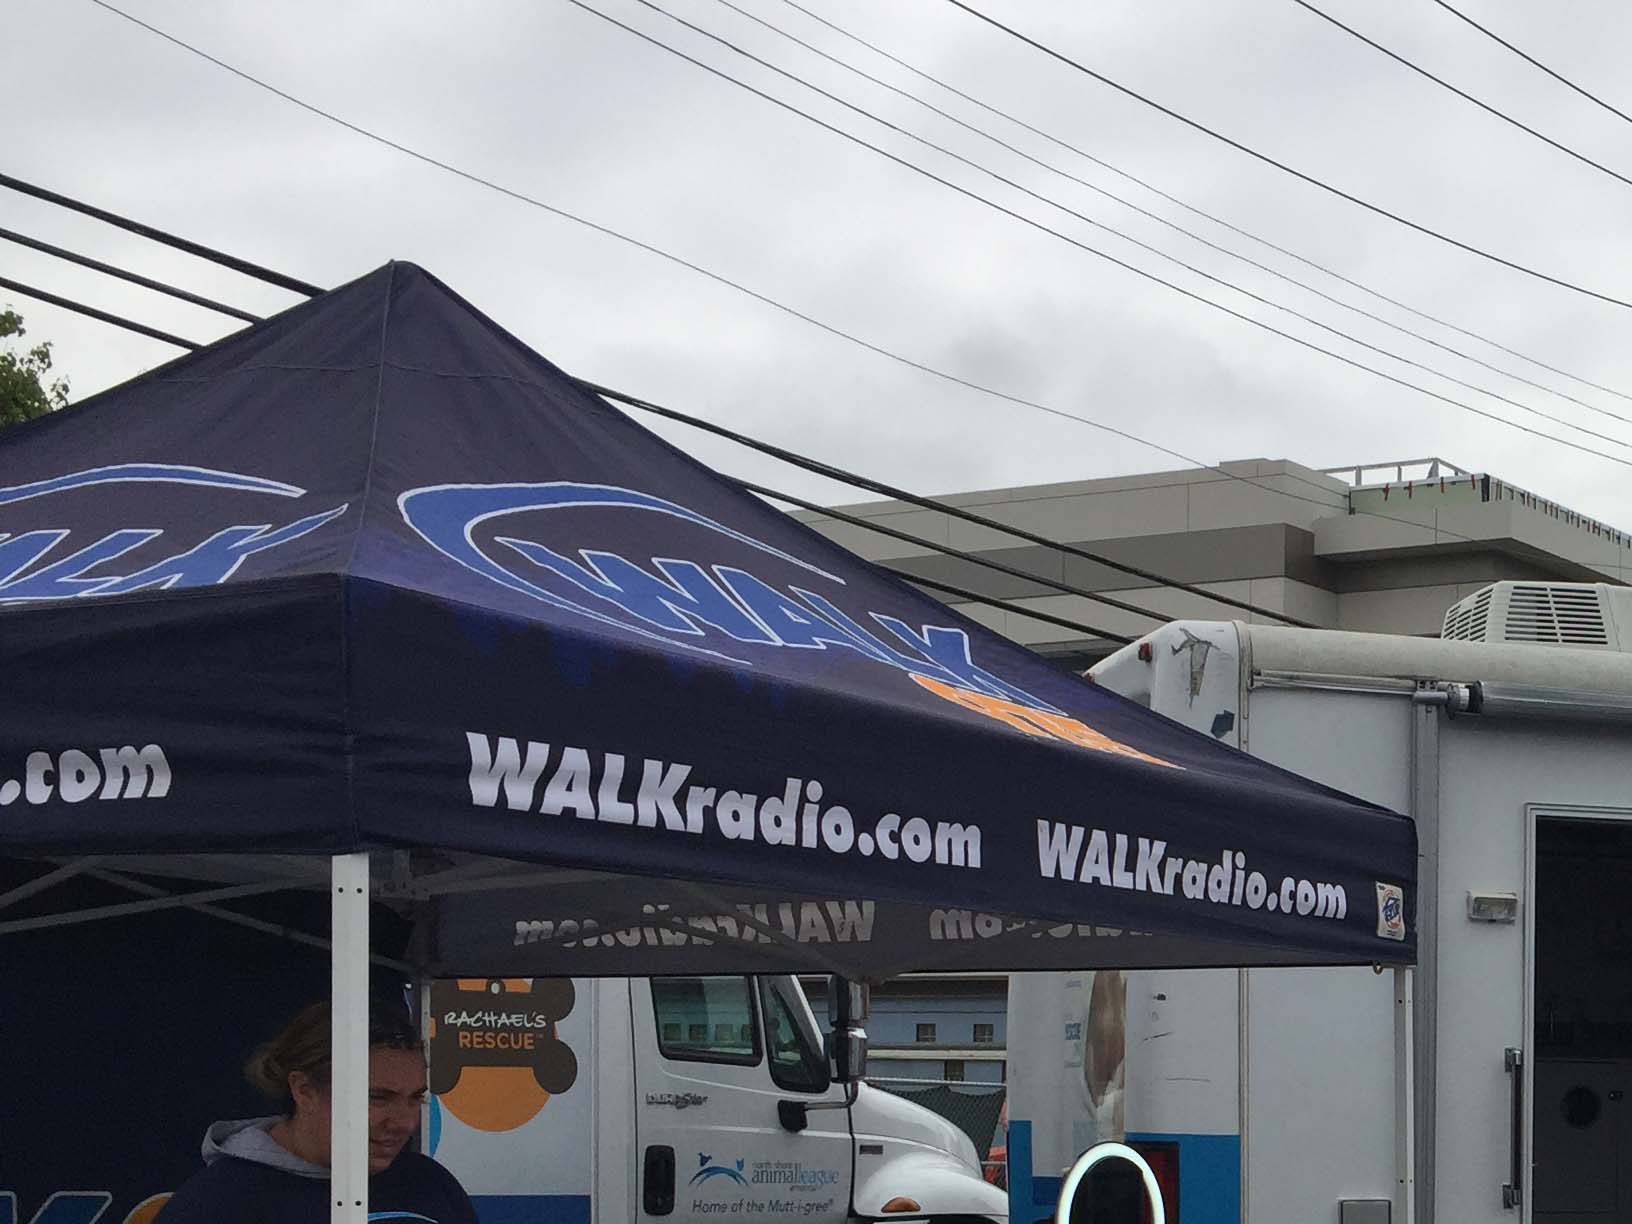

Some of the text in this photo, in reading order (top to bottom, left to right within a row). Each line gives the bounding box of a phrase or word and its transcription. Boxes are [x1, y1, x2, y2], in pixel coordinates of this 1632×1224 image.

[466, 731, 982, 868] WALKradio.com
[1036, 818, 1347, 920] WALKradio.com
[444, 1010, 547, 1029] RACHAEL'S
[459, 1031, 535, 1050] RESCUE
[692, 1199, 728, 1214] Home
[731, 1198, 745, 1213] of
[747, 1198, 765, 1213] the
